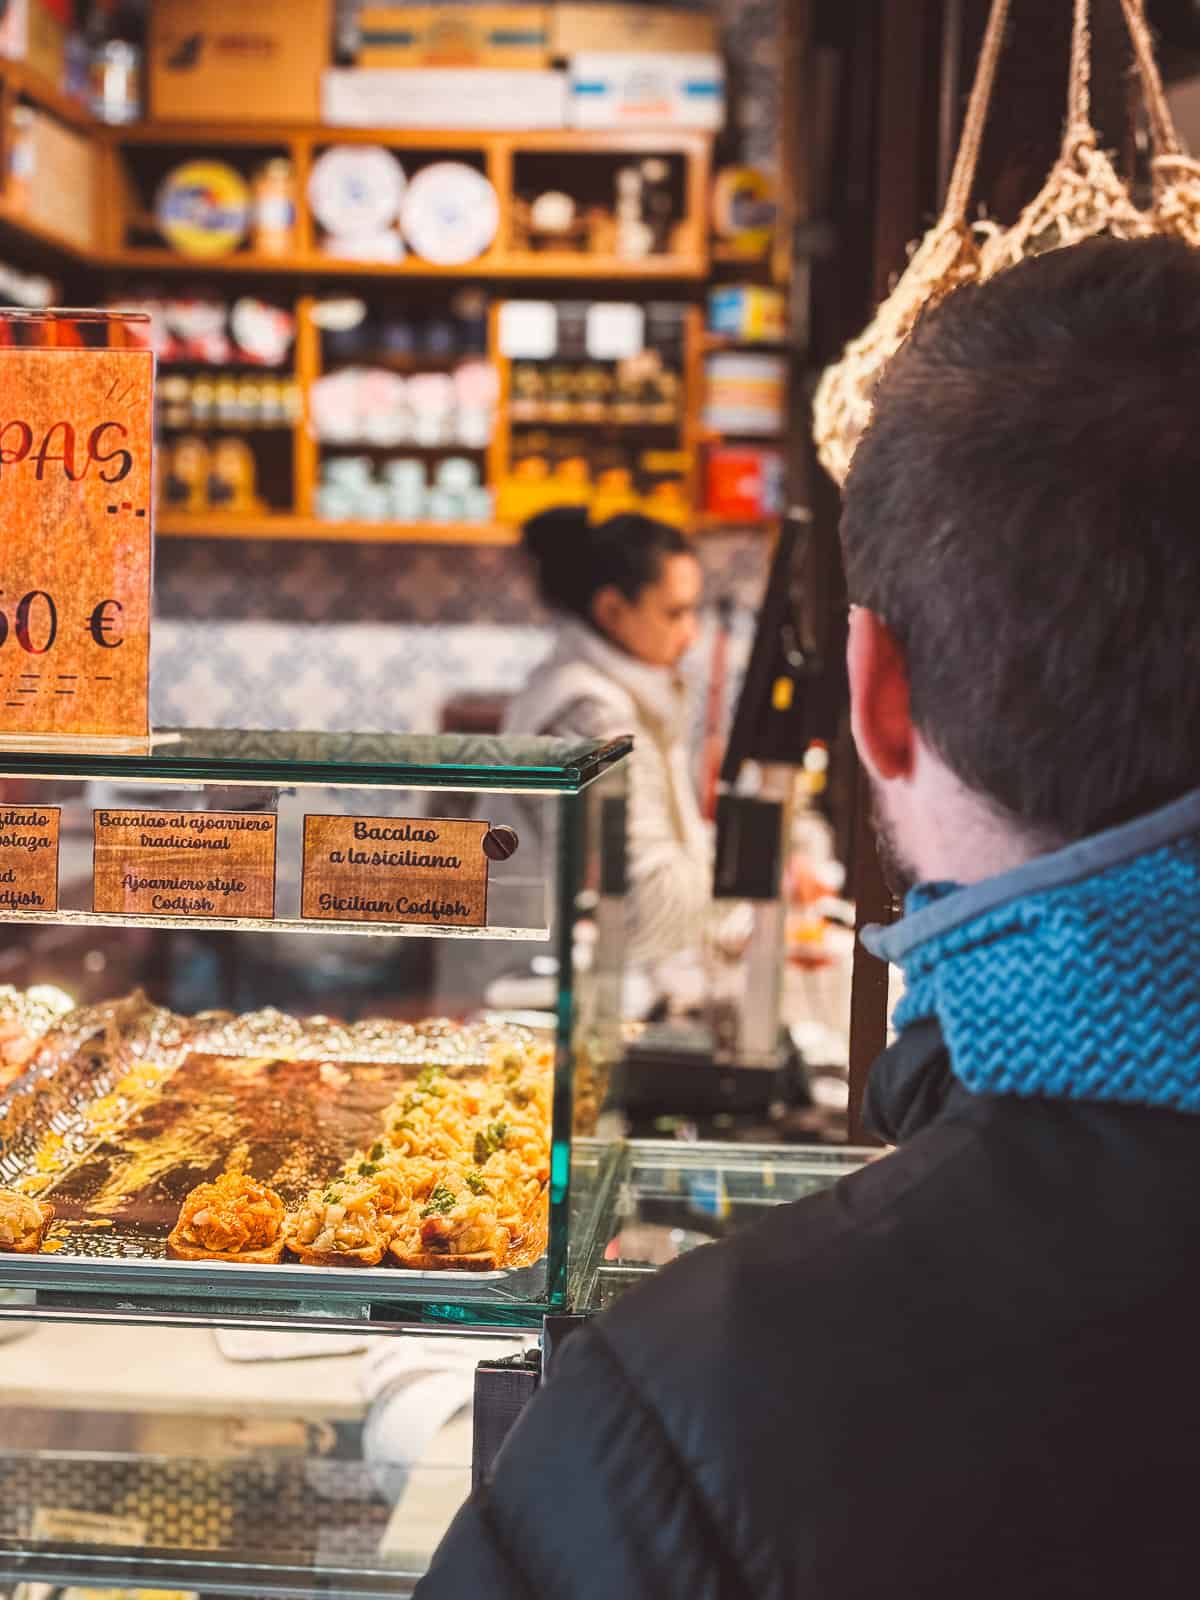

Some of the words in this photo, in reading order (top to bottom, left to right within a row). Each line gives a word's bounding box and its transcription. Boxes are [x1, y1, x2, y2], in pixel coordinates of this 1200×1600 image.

[84, 599, 124, 649] €
[0, 811, 50, 831] itado
[99, 812, 168, 828] Bacalao
[169, 815, 188, 829] al
[189, 817, 272, 834] ajoarriero
[353, 821, 440, 843] Bacalao
[140, 833, 231, 850] tradicional
[329, 850, 345, 864] a
[348, 847, 370, 865] la
[371, 849, 462, 869] siciliana
[121, 873, 207, 892] Ajoarriero
[207, 878, 247, 896] style
[152, 894, 215, 914] Codfish
[319, 893, 393, 914] Sicilian
[396, 896, 470, 920] Codfish
